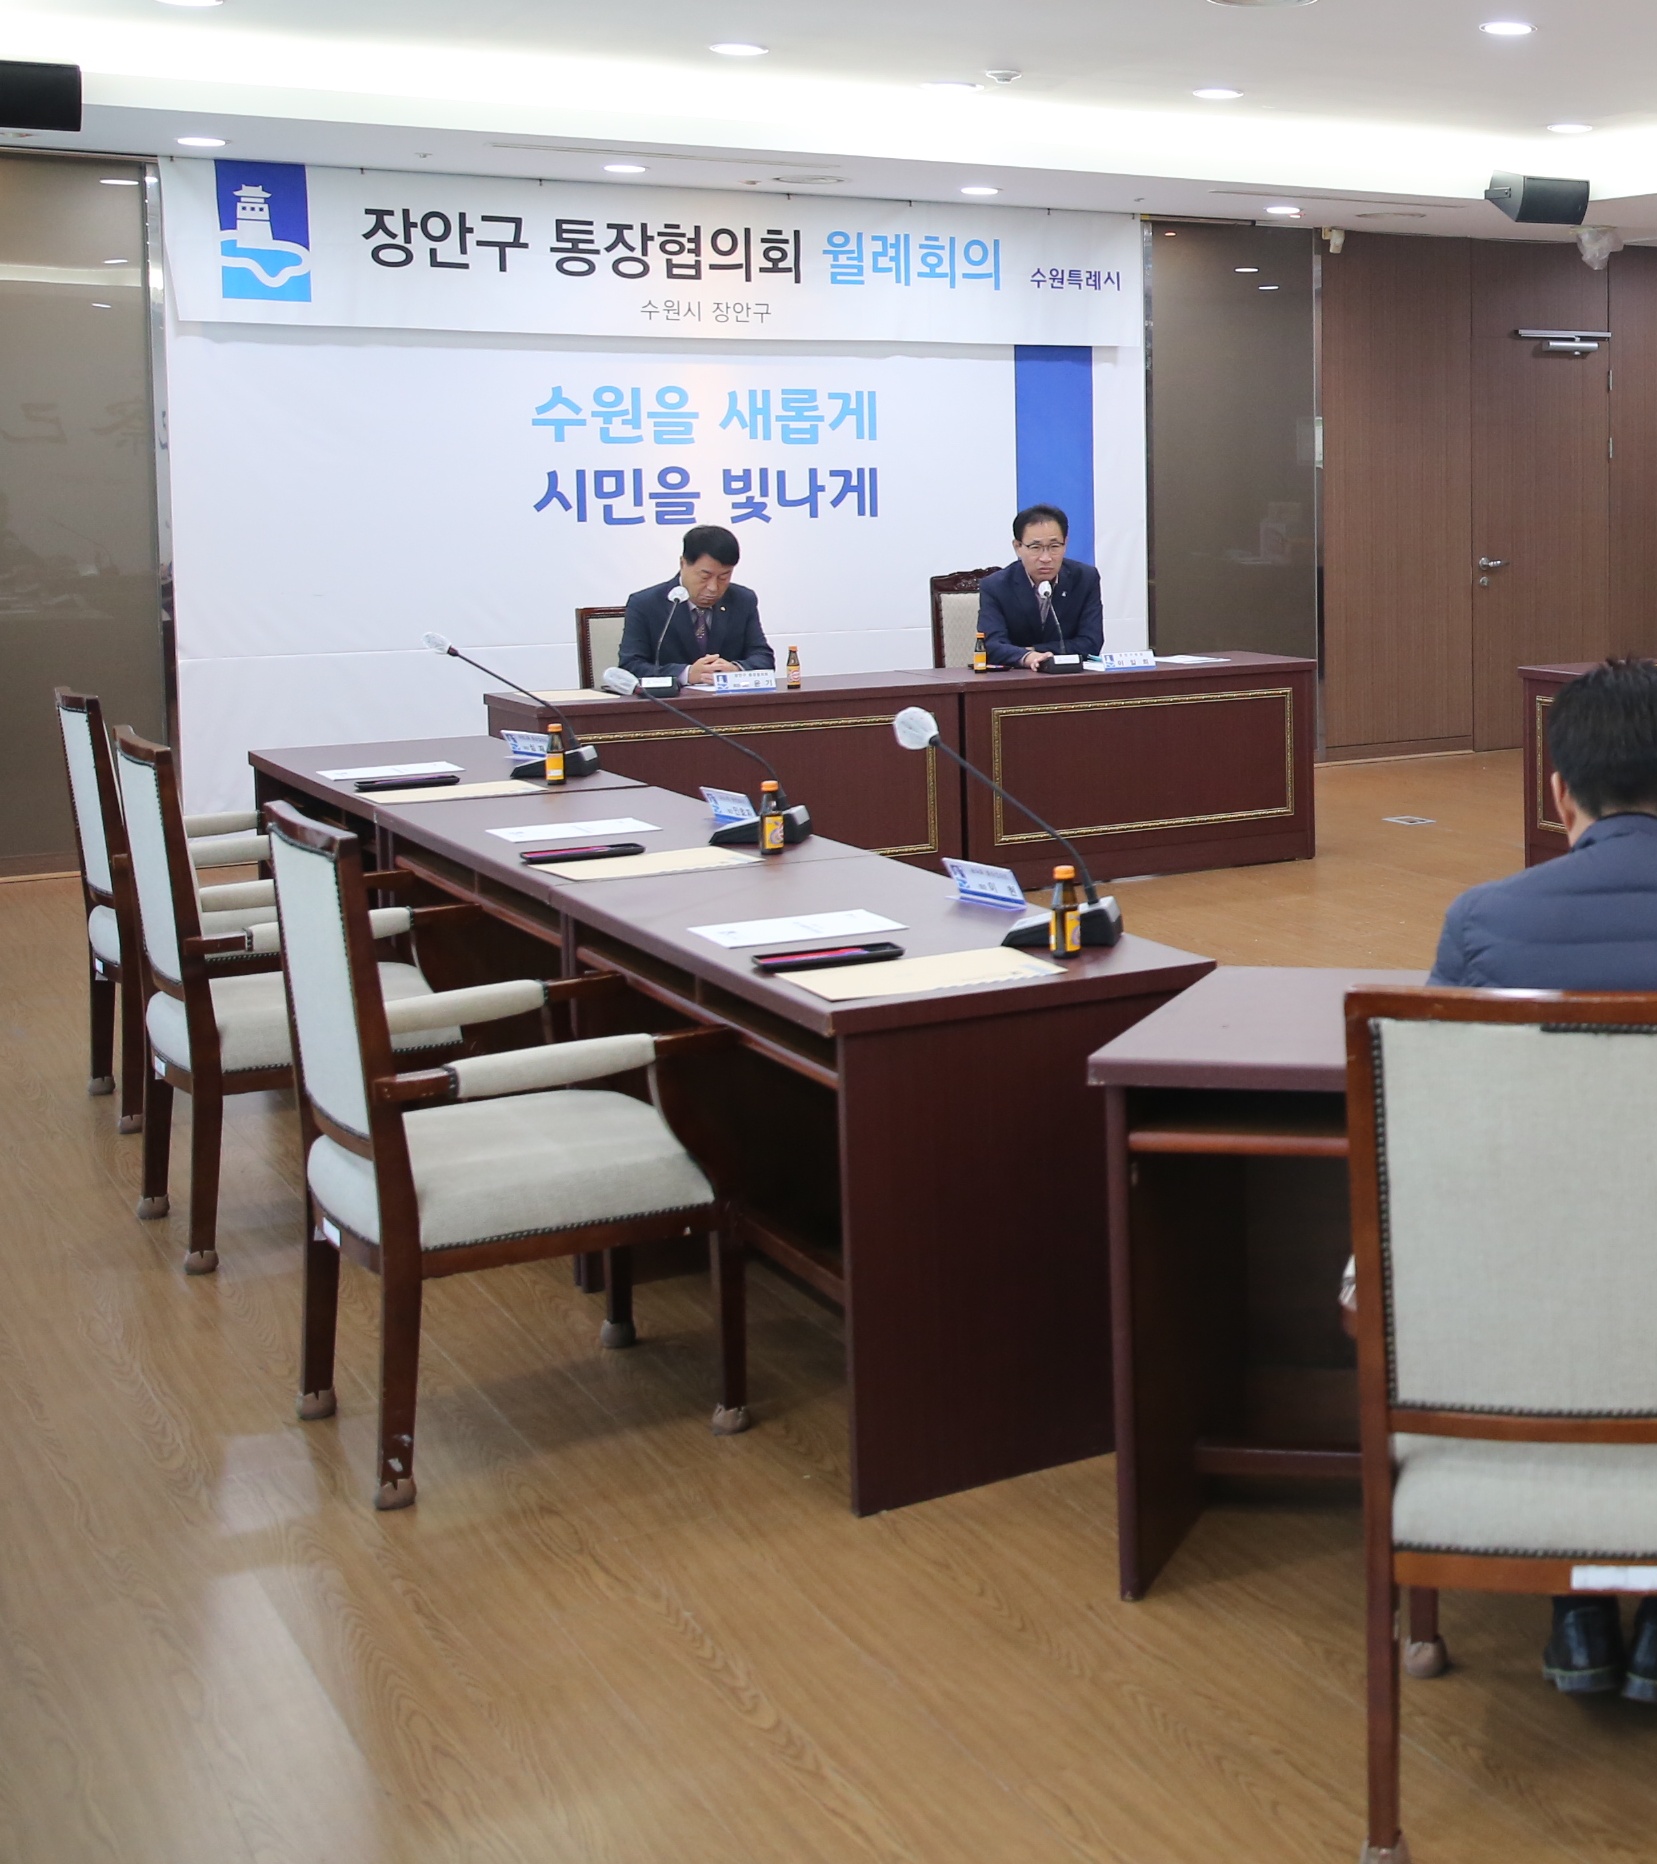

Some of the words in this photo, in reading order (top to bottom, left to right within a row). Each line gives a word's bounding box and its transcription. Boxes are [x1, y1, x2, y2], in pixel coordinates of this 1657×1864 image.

[361, 208, 529, 272] 장안구
[549, 218, 801, 285] 통장협의회
[822, 230, 1001, 291] 월례회의
[1029, 267, 1121, 291] 수원특례시
[640, 300, 702, 322] 수원시
[712, 302, 772, 323] 장안구
[532, 385, 700, 445] 수원을
[719, 388, 878, 445] 새롭게
[533, 466, 701, 525] 시민을
[722, 467, 879, 524] 빛나게
